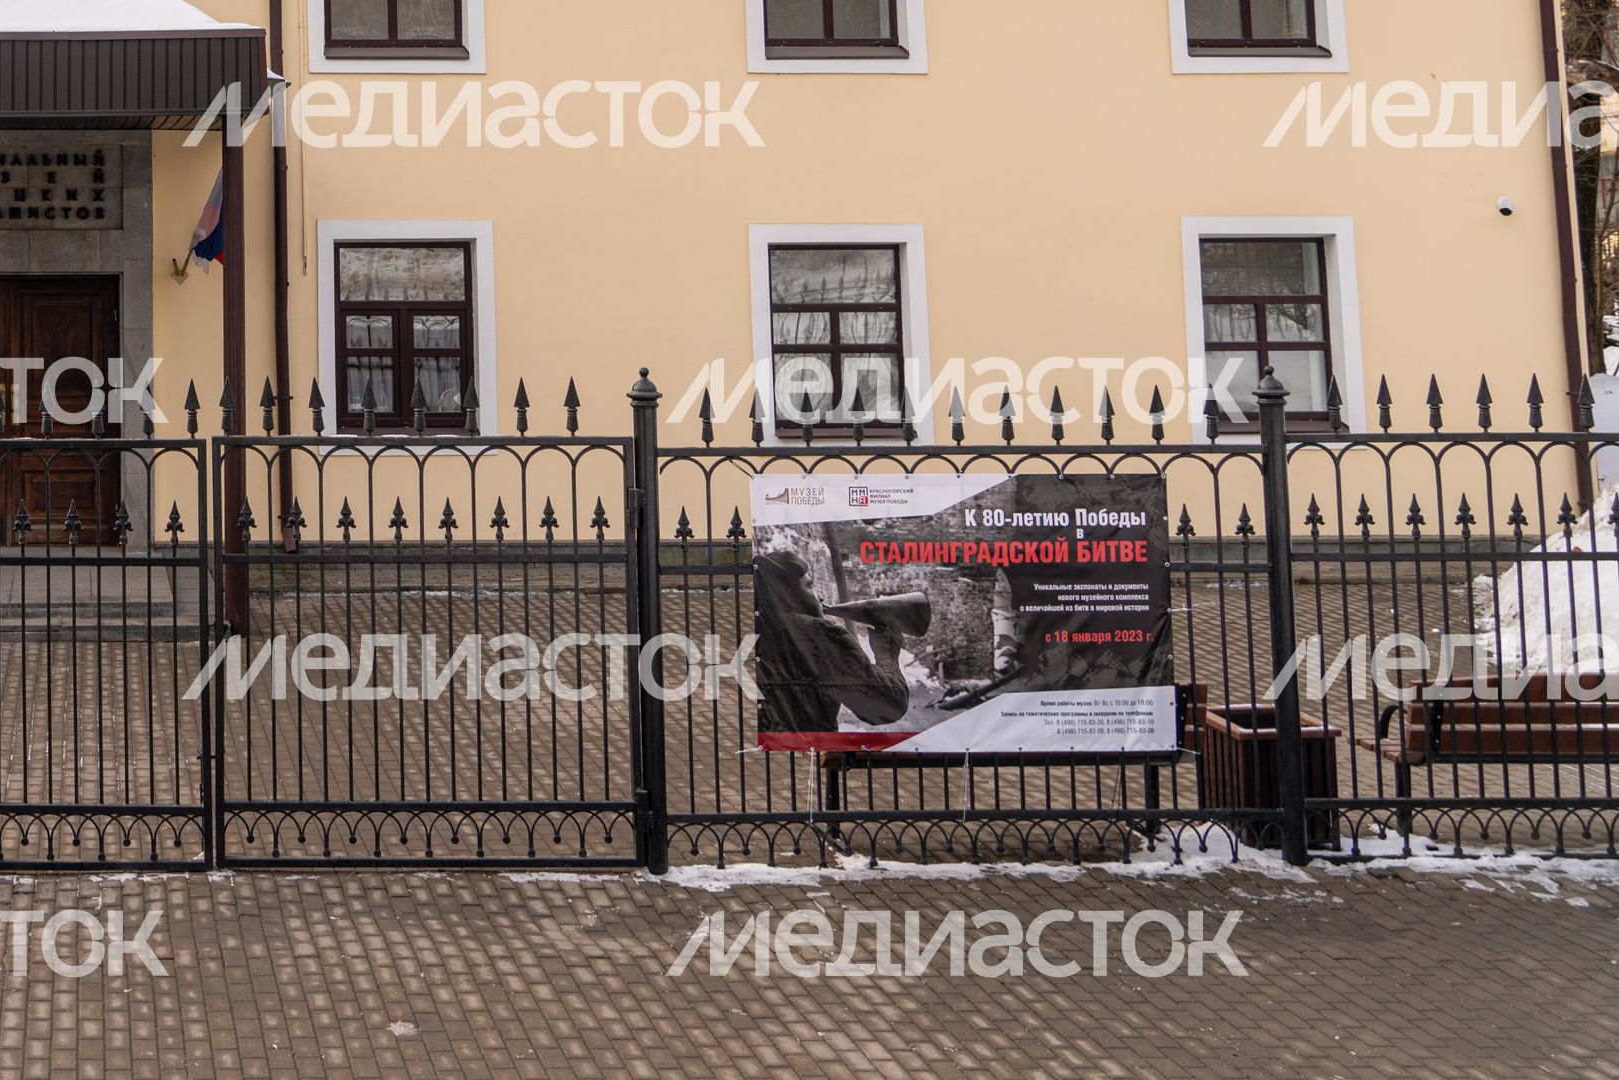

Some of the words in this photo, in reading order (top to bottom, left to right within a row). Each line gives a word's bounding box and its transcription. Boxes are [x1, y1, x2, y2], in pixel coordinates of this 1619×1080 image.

[791, 486, 824, 496] МУЗЕЙ
[791, 497, 824, 505] ПОБЕДЫ
[965, 509, 977, 527] К
[983, 508, 1069, 527] 80-летию
[1075, 508, 1146, 528] Победы
[860, 537, 1069, 567] СТАЛИНГРАДСКОЙ
[1077, 540, 1148, 562] БИТВЕ
[1033, 583, 1072, 591] Уникальные
[1081, 593, 1114, 602] музейного
[1096, 603, 1122, 612] мировой
[1045, 633, 1051, 642] с
[1054, 631, 1068, 642] 18
[1072, 632, 1111, 644] января
[1114, 630, 1143, 642] 2023
[1146, 632, 1154, 642] г.
